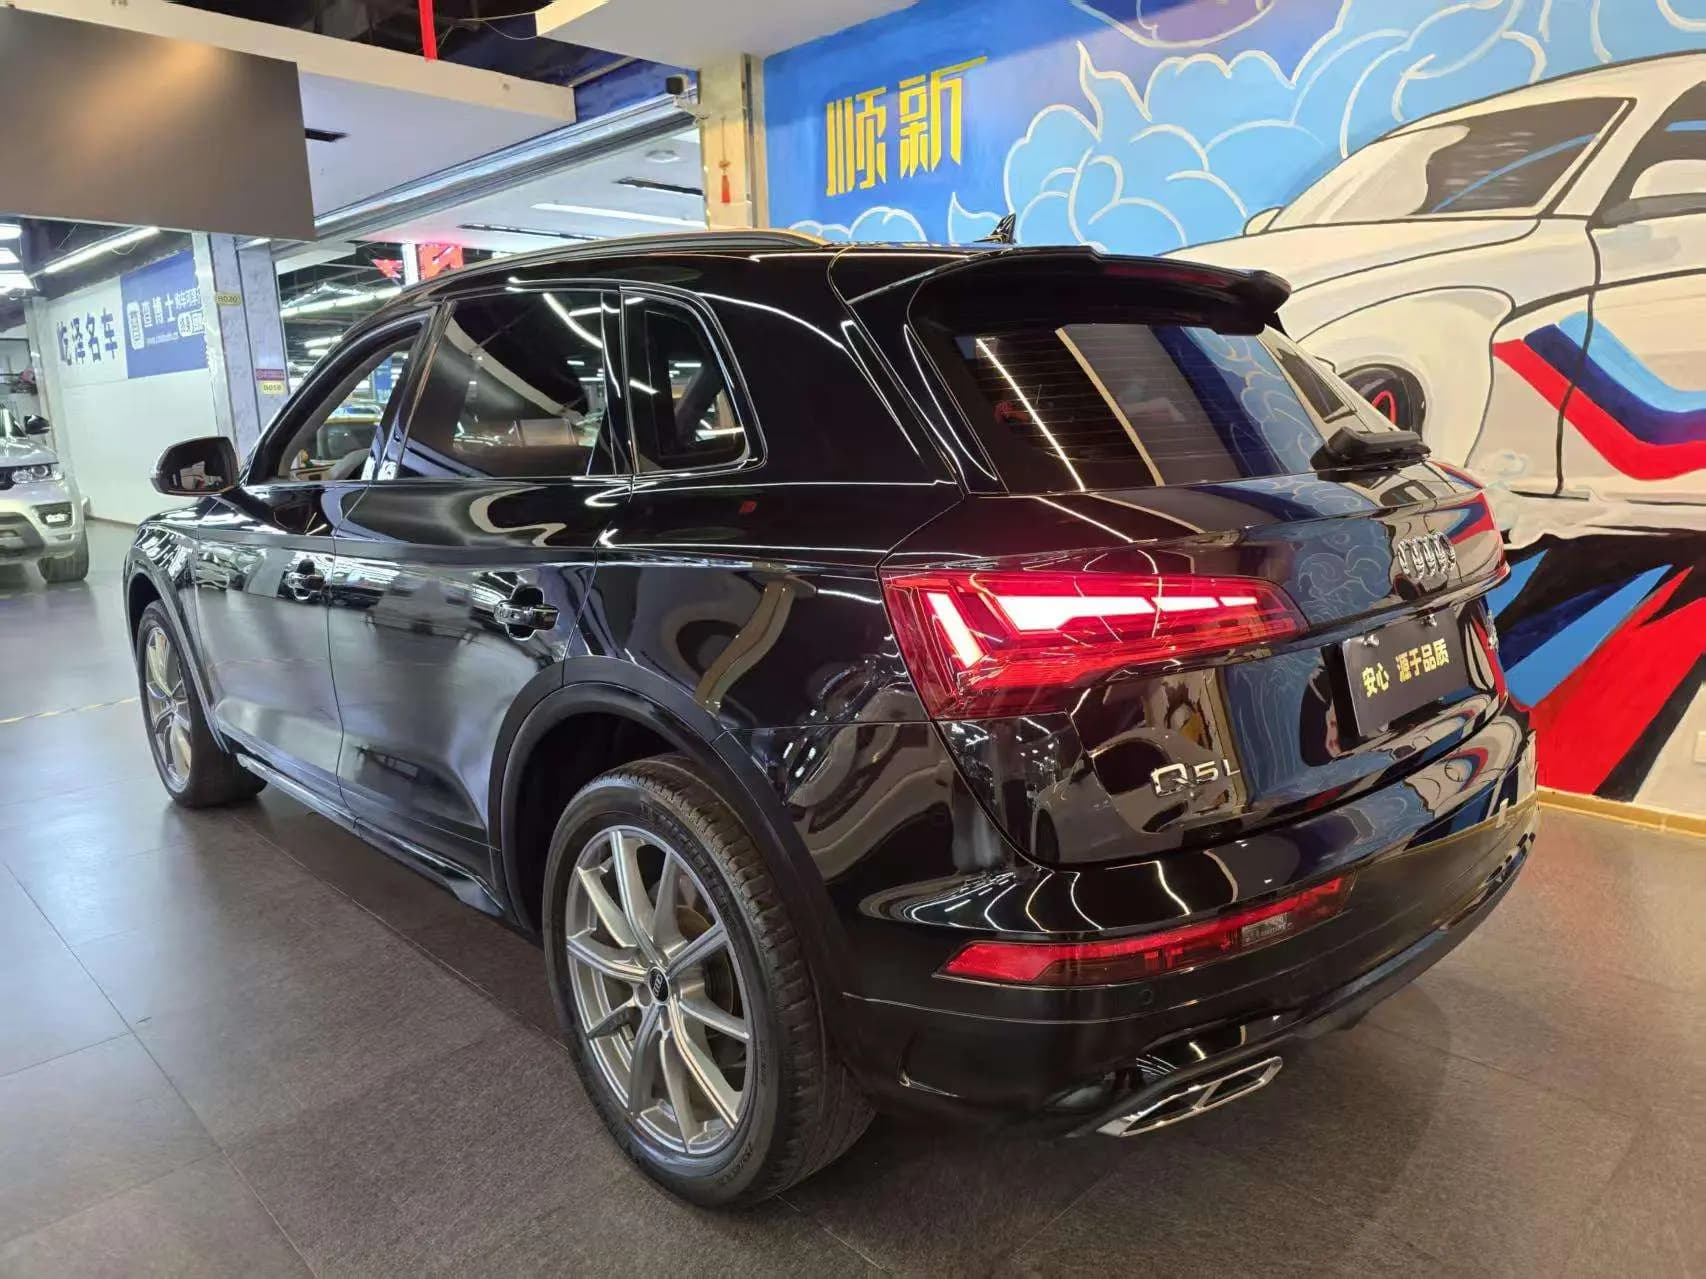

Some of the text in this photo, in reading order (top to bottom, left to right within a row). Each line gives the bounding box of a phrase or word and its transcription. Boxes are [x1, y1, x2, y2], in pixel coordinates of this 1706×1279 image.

[826, 56, 988, 197] 顺新
[1362, 638, 1449, 697] 安心 源于品质
[1151, 759, 1240, 797] Q5L
